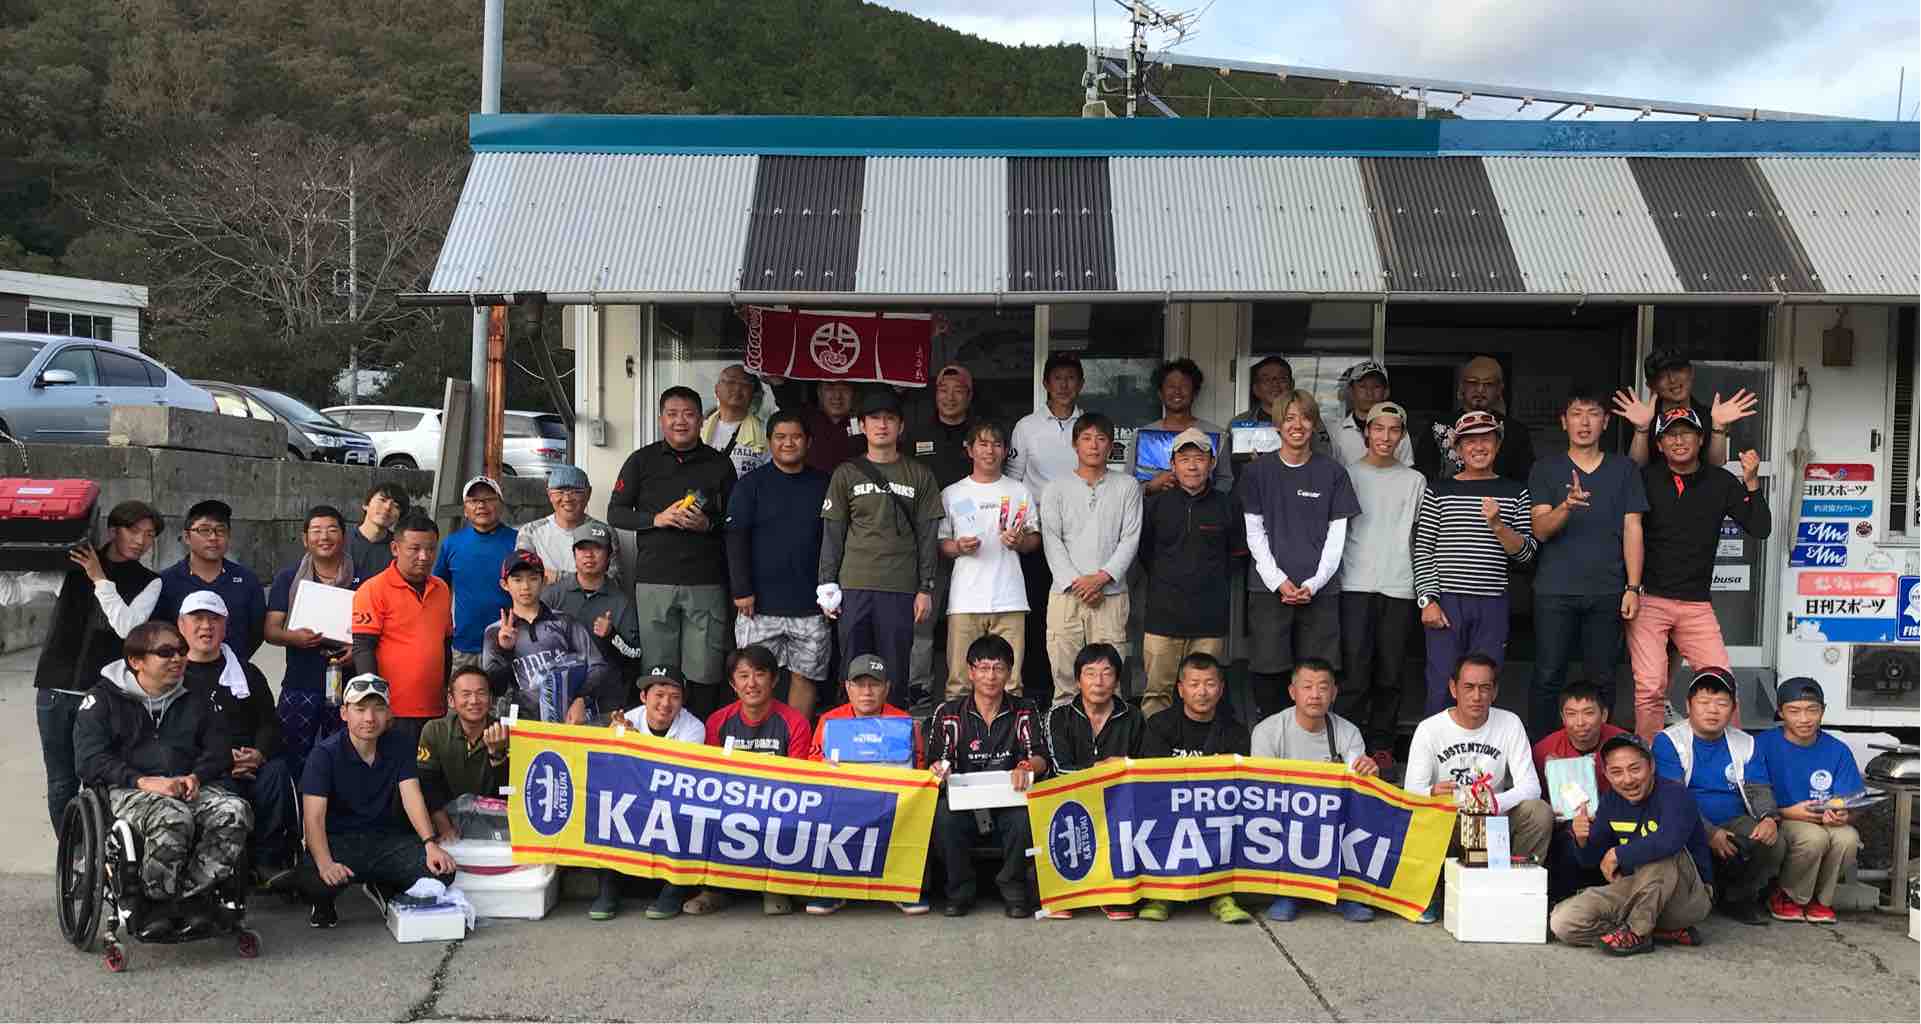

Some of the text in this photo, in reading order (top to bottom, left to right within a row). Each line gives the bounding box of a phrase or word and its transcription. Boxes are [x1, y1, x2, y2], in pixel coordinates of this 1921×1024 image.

[1806, 599, 1886, 614] 日刊スポーツ
[558, 771, 569, 819] KATSUKI
[650, 768, 823, 814] PROSHOP
[1170, 785, 1342, 818] PROSHOP
[598, 790, 880, 873] KATSUKI
[1080, 815, 1093, 860] KATSUKI
[1119, 815, 1391, 881] KATSUKI
